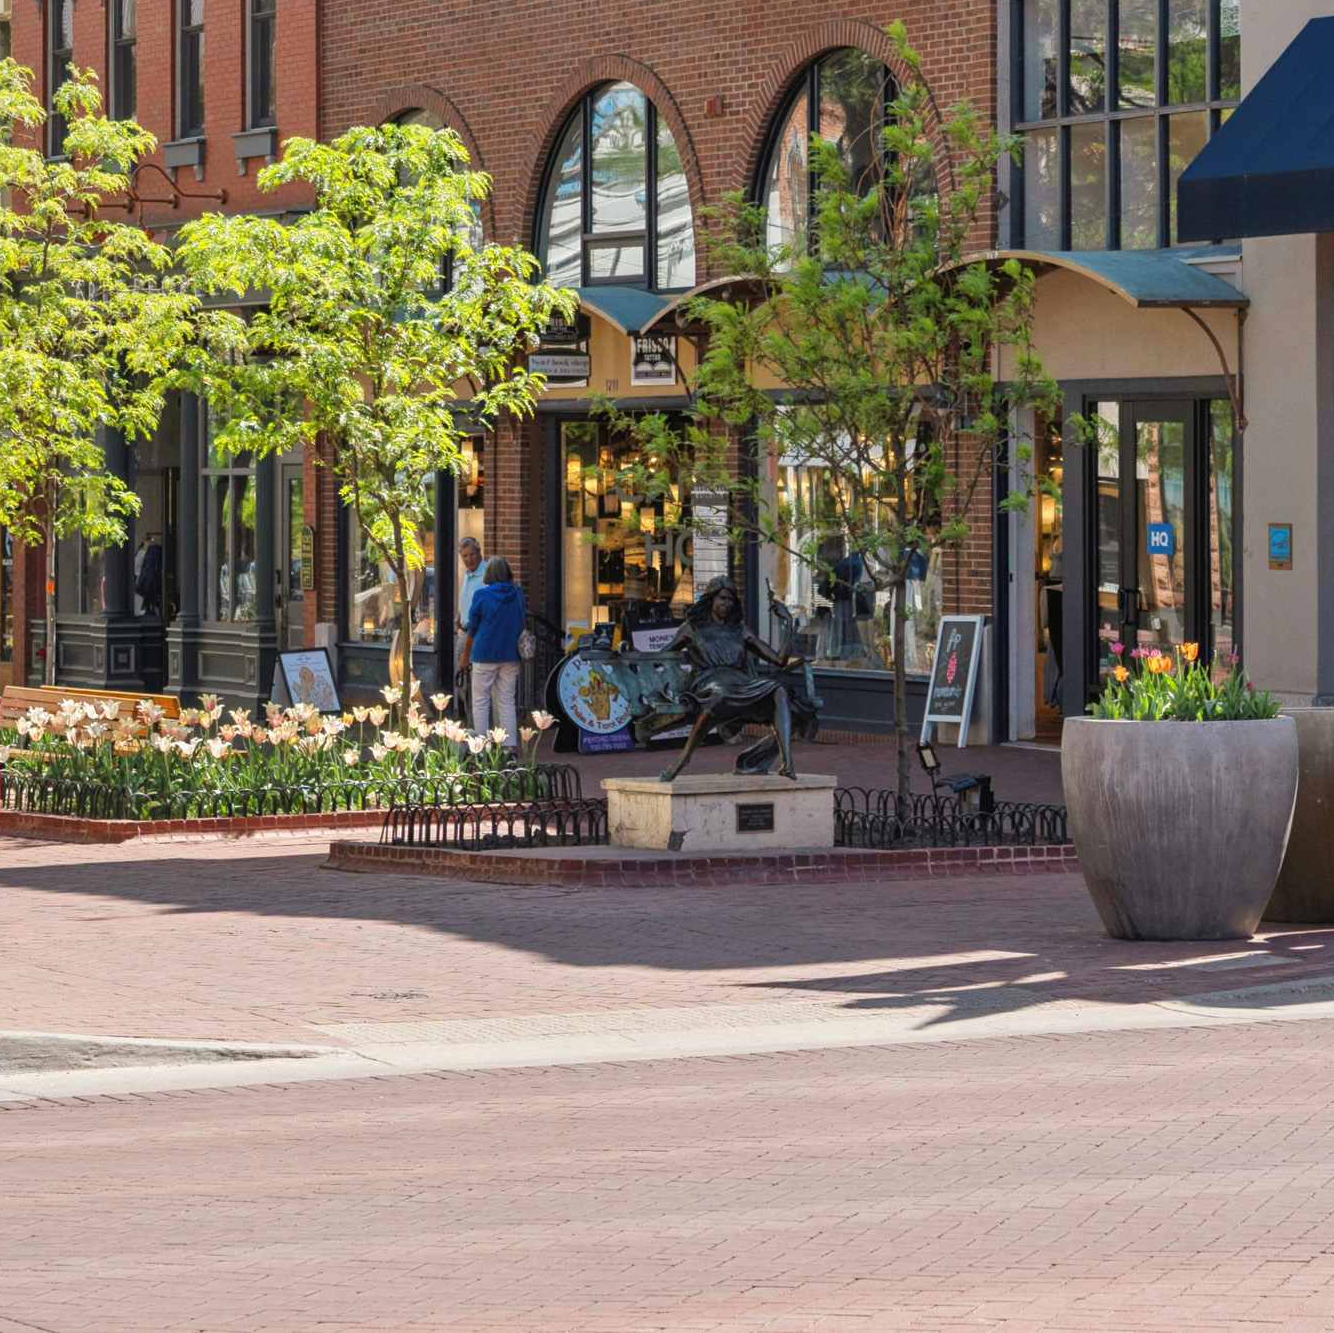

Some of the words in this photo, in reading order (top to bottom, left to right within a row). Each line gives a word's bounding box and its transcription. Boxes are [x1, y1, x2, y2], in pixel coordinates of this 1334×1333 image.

[644, 354, 662, 362] TATTOO
[552, 358, 570, 367] book
[571, 358, 589, 368] shop
[1151, 532, 1168, 547] HQ
[649, 634, 674, 643] MONEY
[570, 705, 587, 723] Palm
[588, 719, 596, 728] &
[597, 720, 617, 730] Tarot
[584, 736, 609, 745] PSYCHIC
